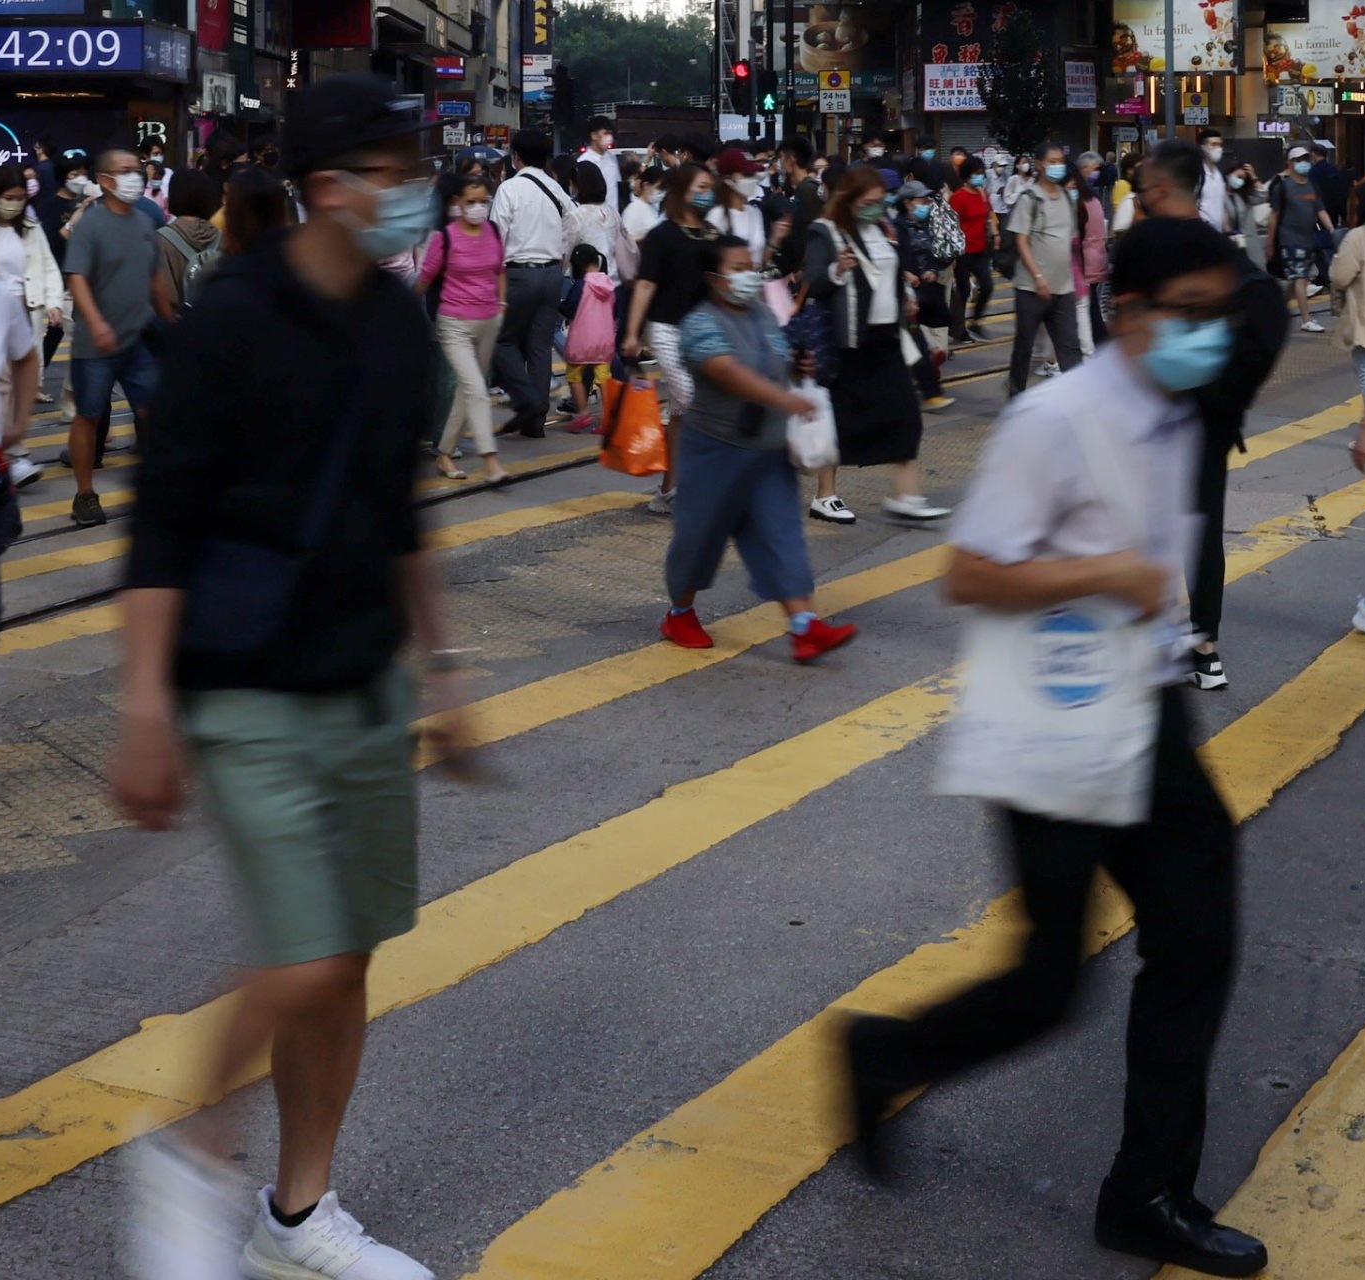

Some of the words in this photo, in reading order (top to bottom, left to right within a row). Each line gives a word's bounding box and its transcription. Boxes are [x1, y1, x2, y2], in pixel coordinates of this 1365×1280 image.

[1143, 24, 1153, 37] la
[1155, 24, 1194, 37] faille
[1294, 38, 1304, 51] la
[1304, 37, 1342, 50] famille
[822, 91, 834, 100] 24
[834, 91, 848, 100] hrs
[1316, 91, 1333, 104] SUN
[825, 100, 845, 112] 全日
